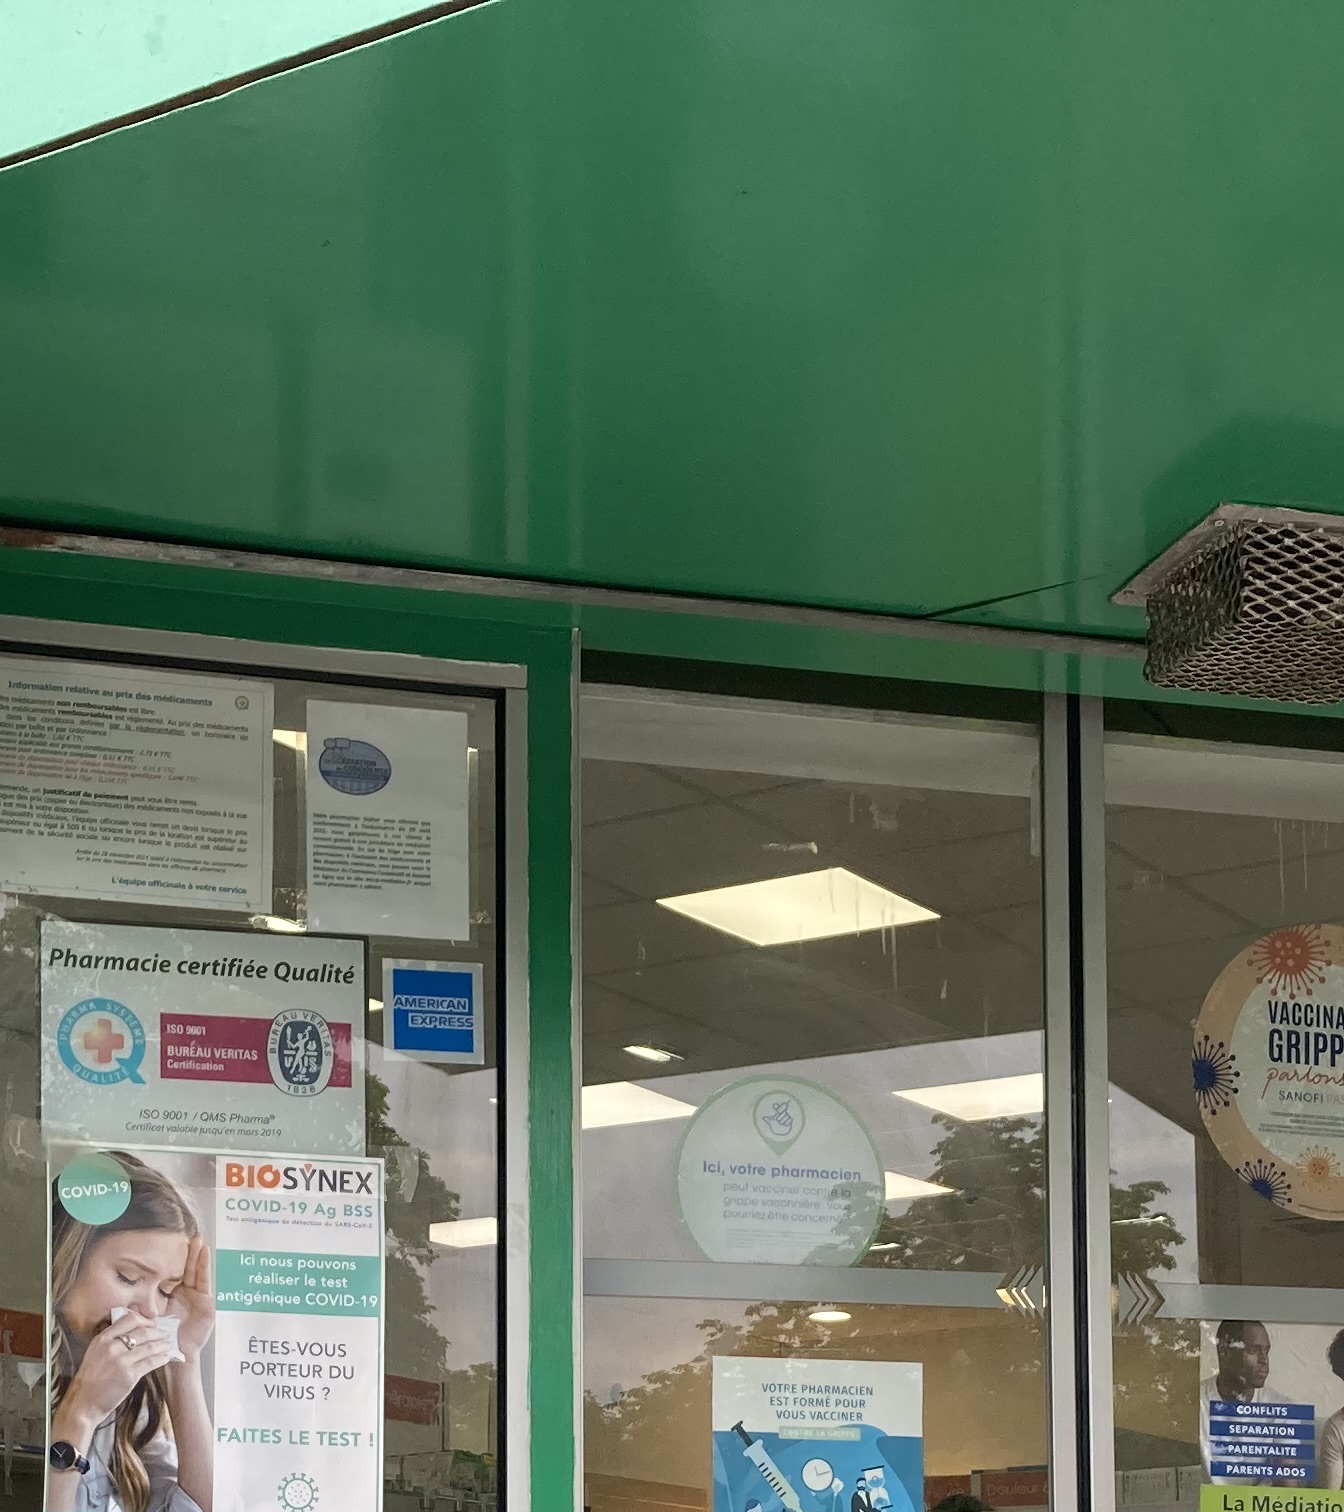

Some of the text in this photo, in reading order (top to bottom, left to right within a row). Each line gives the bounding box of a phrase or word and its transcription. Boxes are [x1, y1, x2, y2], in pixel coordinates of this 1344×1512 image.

[48, 948, 355, 985] Pharmacie certifiée Qualité
[393, 997, 467, 1011] AMERICAN
[410, 1015, 474, 1028] EXPRESS
[214, 1048, 258, 1061] VERITAS
[225, 1162, 373, 1195] BIOSYNEX
[730, 1164, 766, 1177] votre
[771, 1165, 861, 1183] pharmacien
[61, 1180, 129, 1201] COVID-19
[248, 1337, 347, 1358] ÊTES-VOUS
[240, 1362, 354, 1380] PORTEUR DU
[264, 1384, 330, 1400] VIRUS ?
[762, 1383, 874, 1397] VOTRE PHARMACIEN
[770, 1394, 867, 1409] EST FORMÉ POUR
[776, 1410, 863, 1422] VOUS VACCINER
[1236, 1404, 1288, 1417] CONFLITS
[217, 1427, 283, 1445] FAITES
[288, 1430, 310, 1445] LE
[316, 1431, 362, 1447] TEST
[1229, 1424, 1295, 1437] SEPARATION
[1227, 1444, 1297, 1457] PARENTALITE
[1223, 1494, 1245, 1512] La
